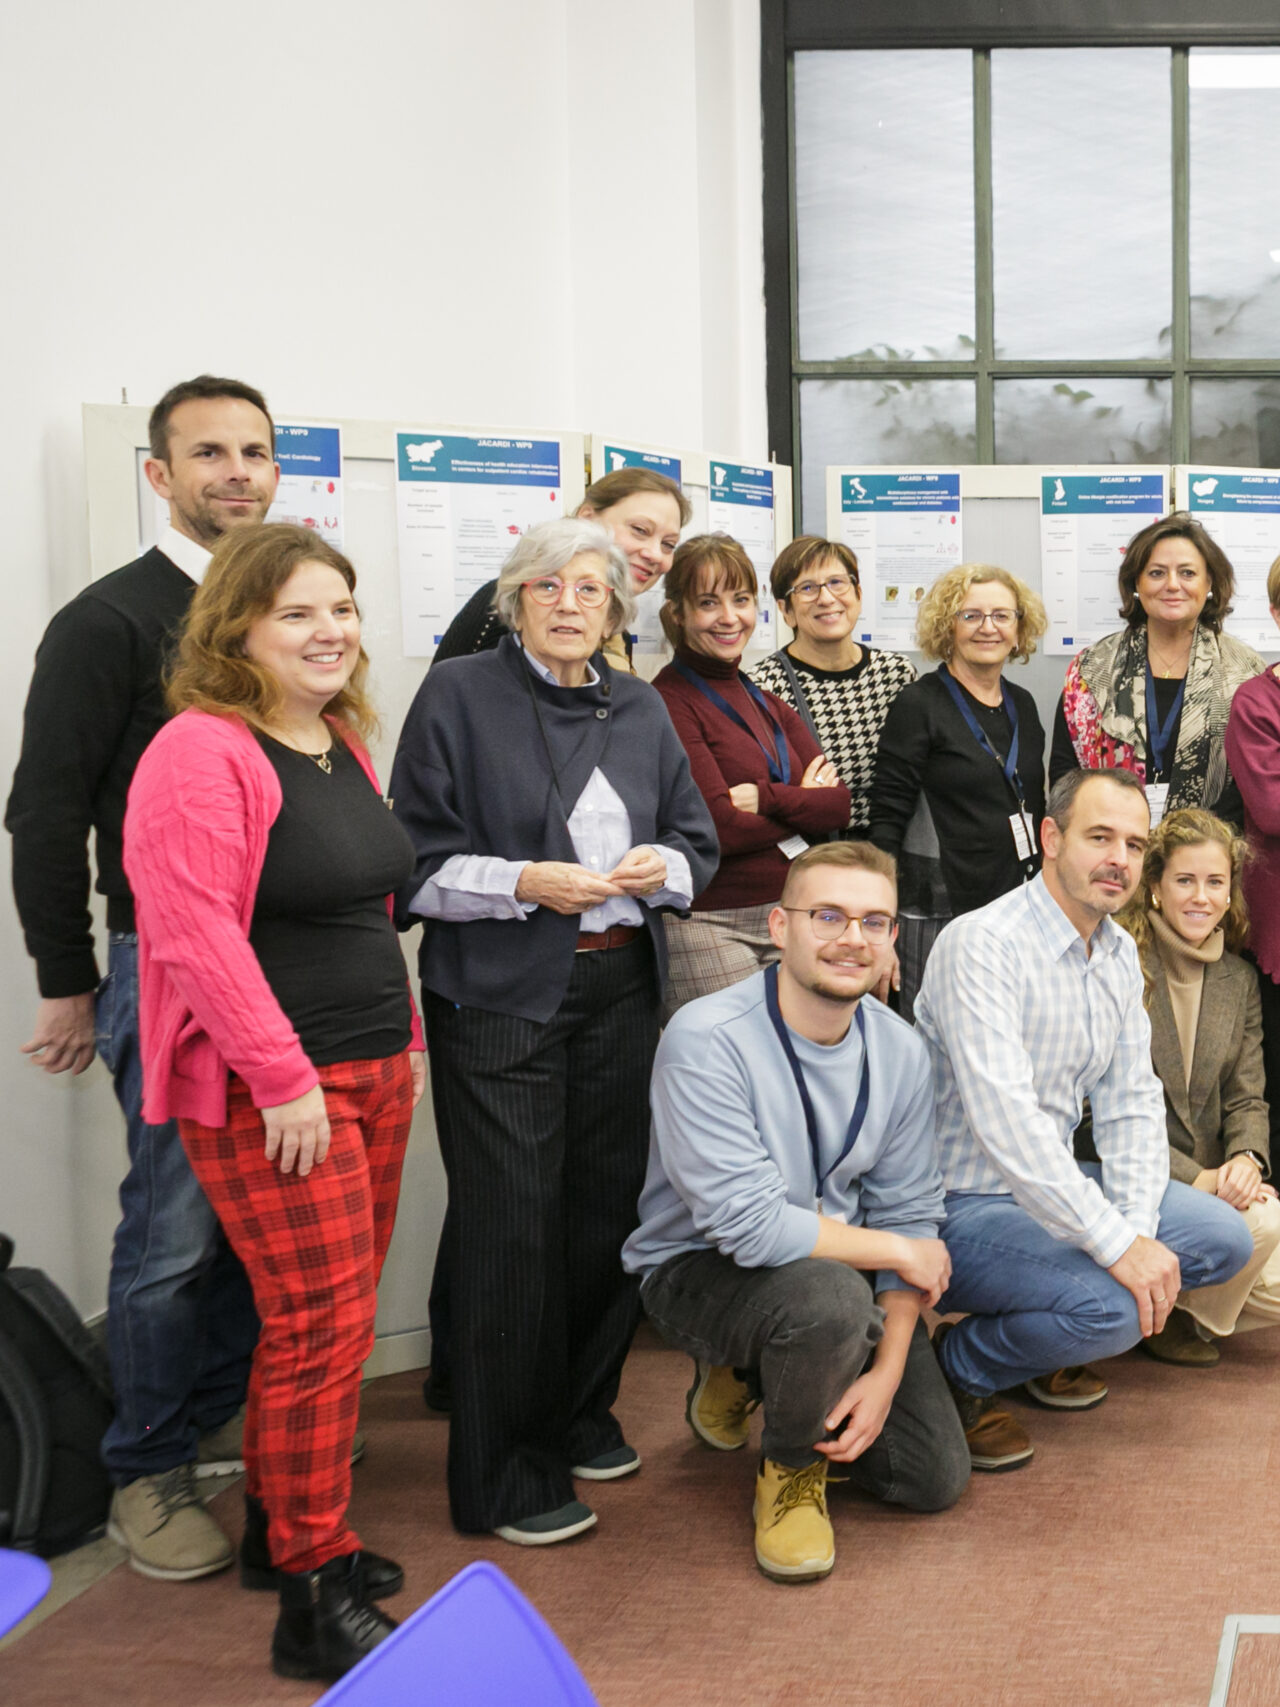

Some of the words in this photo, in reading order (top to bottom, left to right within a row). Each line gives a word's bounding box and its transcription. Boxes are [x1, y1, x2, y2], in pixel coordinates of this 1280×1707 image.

[289, 428, 309, 437] WP9
[477, 439, 511, 448] JACARDI
[516, 441, 533, 450] WP9
